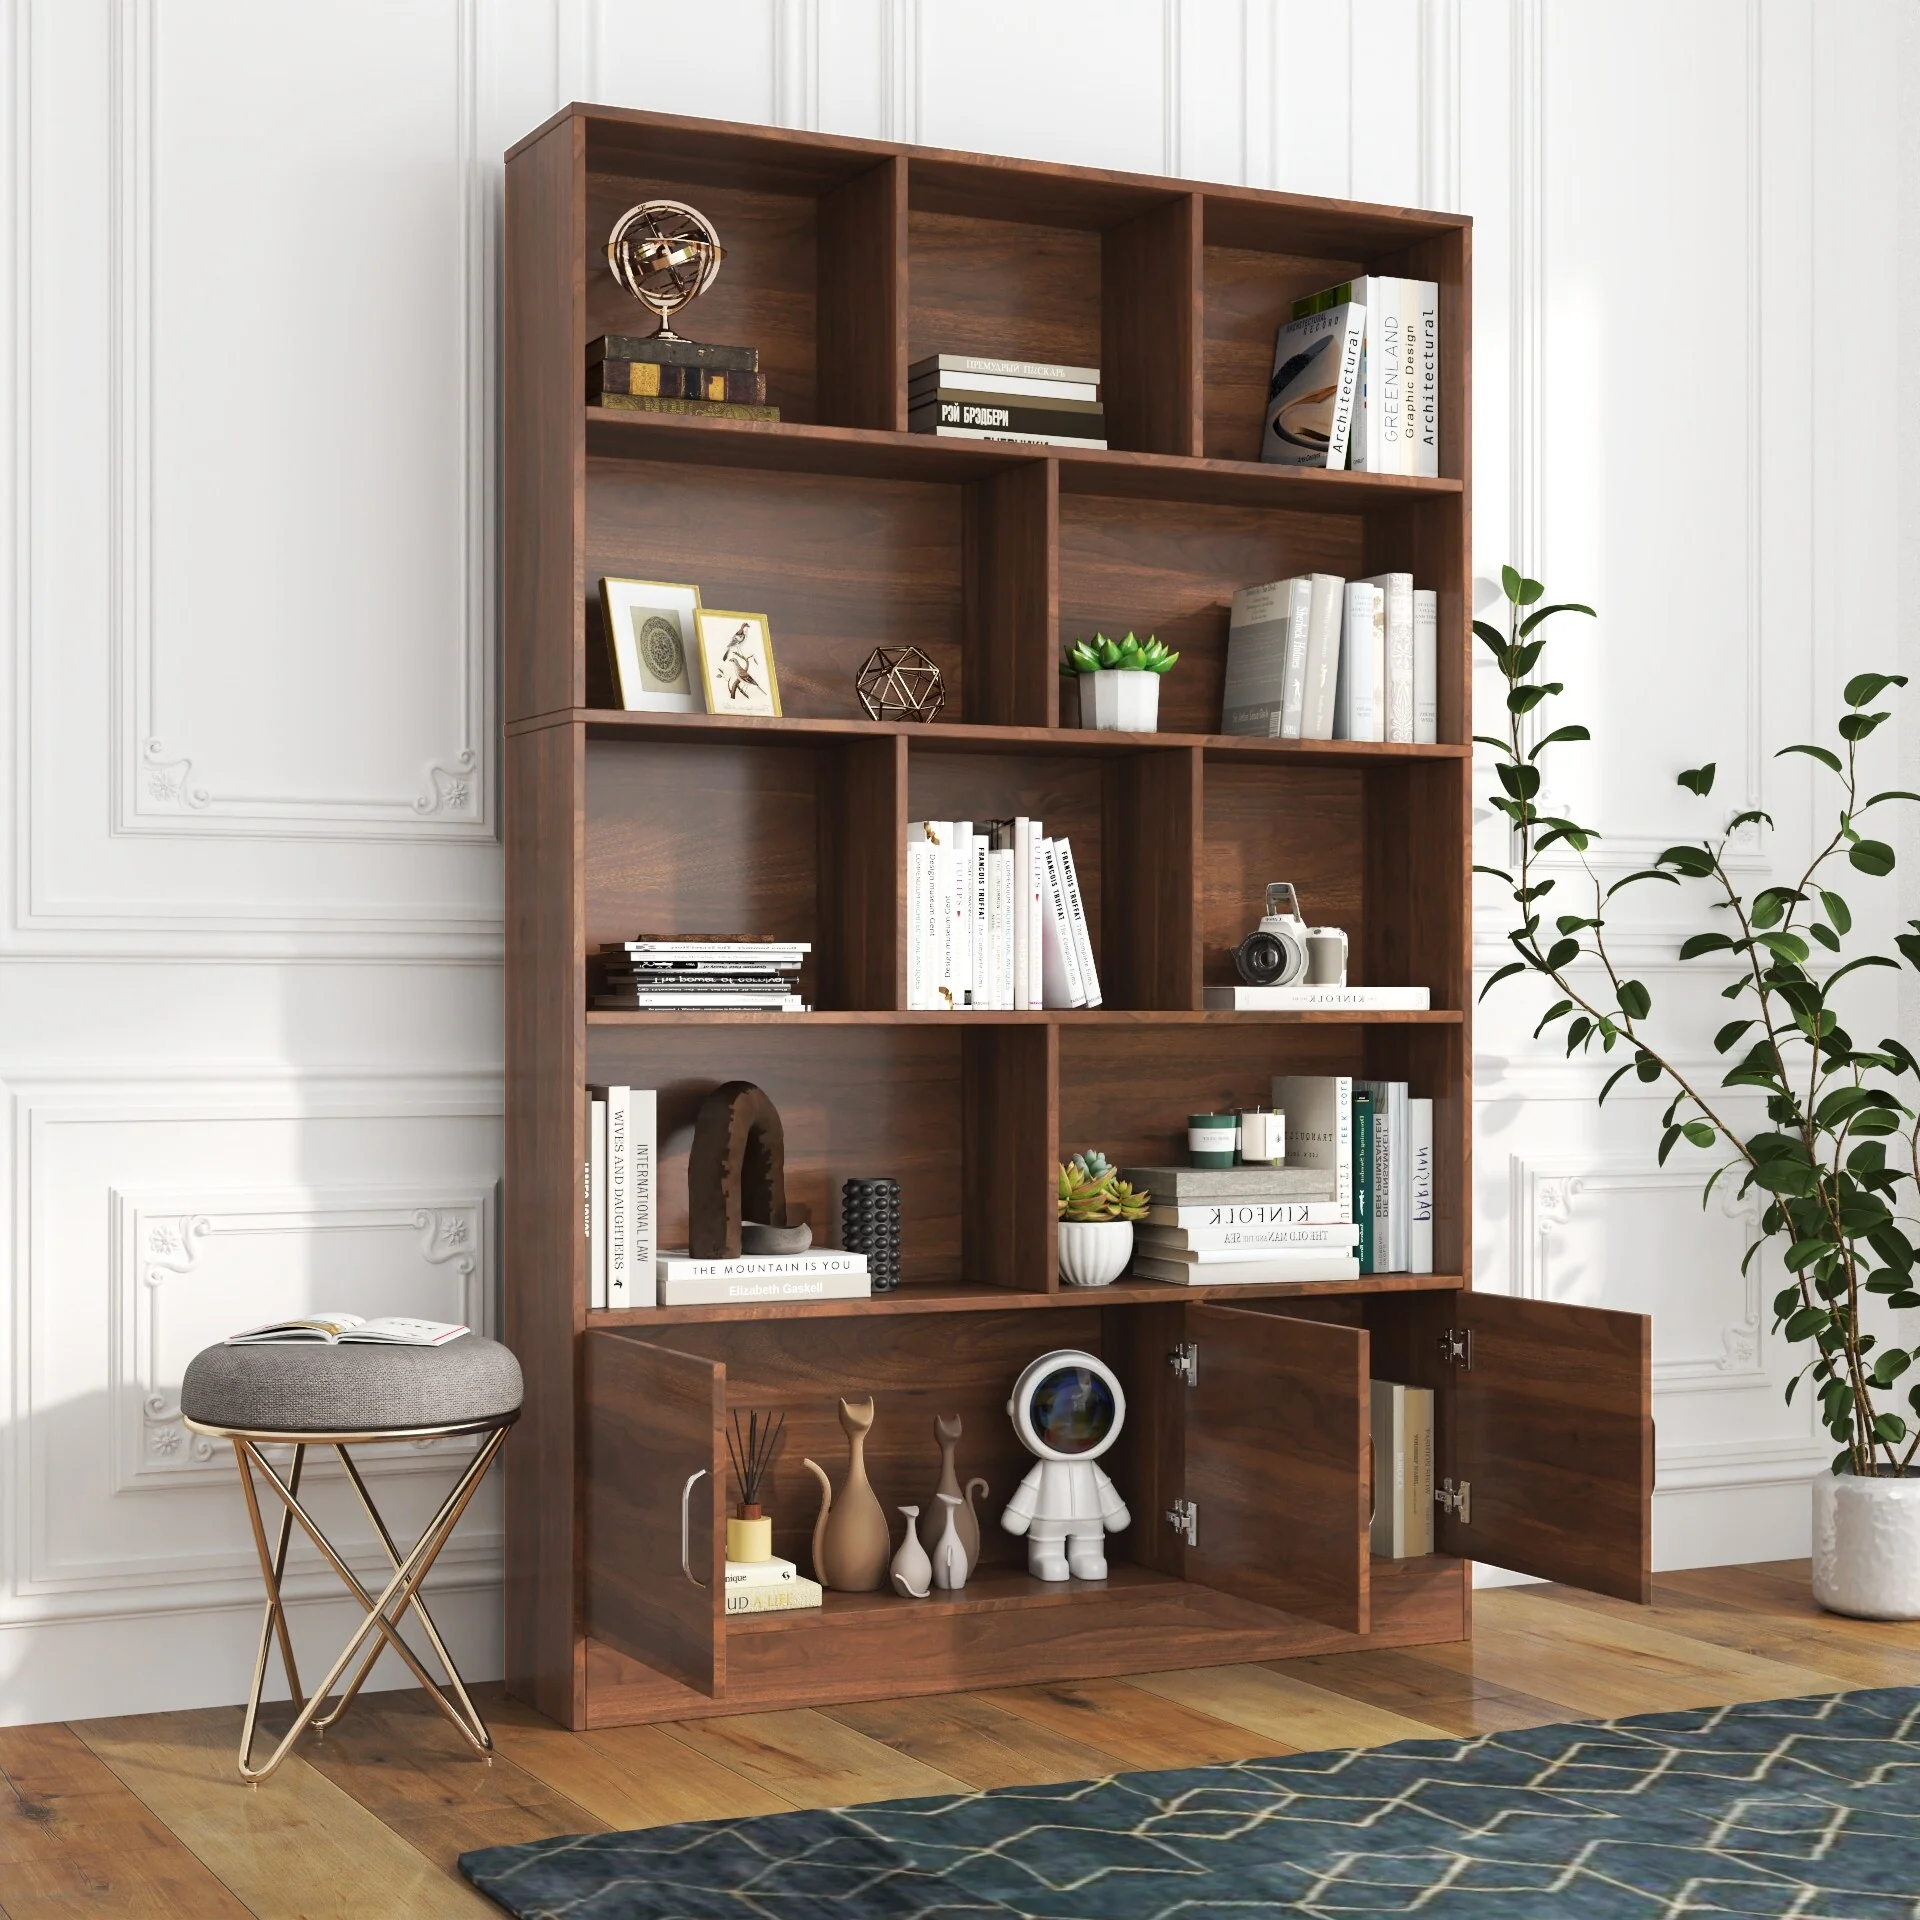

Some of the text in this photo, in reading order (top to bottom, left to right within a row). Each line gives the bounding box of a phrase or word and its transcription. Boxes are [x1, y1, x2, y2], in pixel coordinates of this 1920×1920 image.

[1303, 316, 1340, 336] RECORD
[966, 359, 1020, 375] ПРЕМУДРЫЙ
[1384, 316, 1399, 442] GREENLAND
[1405, 325, 1416, 438] Graphic Design
[1422, 309, 1434, 445] Architectural
[1333, 329, 1360, 453] Architectural
[941, 402, 1009, 427] РЭЙ БРЭДБЕРИ
[1292, 606, 1308, 669] Sherlock Holmes
[928, 854, 937, 881] Design
[1044, 850, 1058, 887] FRANCOIS
[1053, 890, 1065, 921] TRUFFAT
[1061, 851, 1074, 887] FRANCOIS
[1070, 890, 1081, 921] TRUFFAT
[943, 951, 952, 978] Design
[613, 1110, 625, 1270] WIVES AND DAUGHTERS
[636, 1144, 650, 1262] INTERNATIONAL LAW
[692, 1261, 851, 1276] THE MOUNTAIN IS YOU
[728, 1282, 823, 1297] Elizabeth Gaskell
[725, 1574, 747, 1584] nique
[727, 1592, 793, 1610] UD A LIFE
